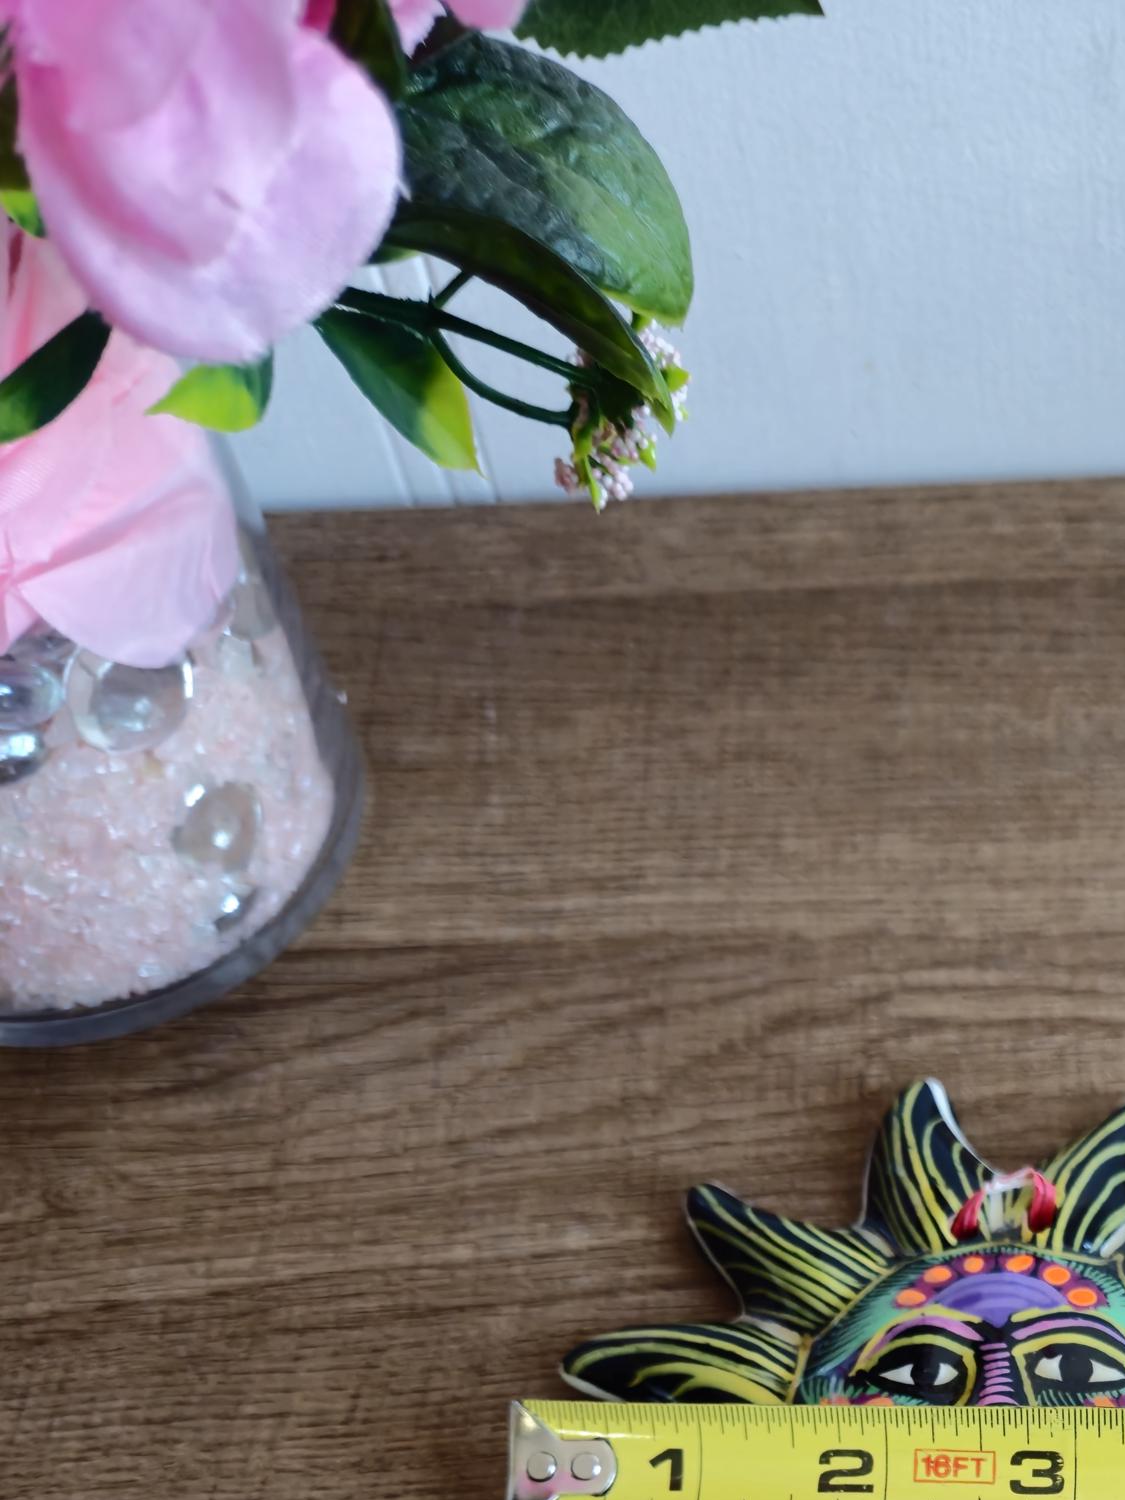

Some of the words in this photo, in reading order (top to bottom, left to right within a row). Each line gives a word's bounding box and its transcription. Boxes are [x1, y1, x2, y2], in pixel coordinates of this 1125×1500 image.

[649, 1448, 684, 1492] 1
[817, 1449, 874, 1493] 2
[1009, 1450, 1065, 1495] 3
